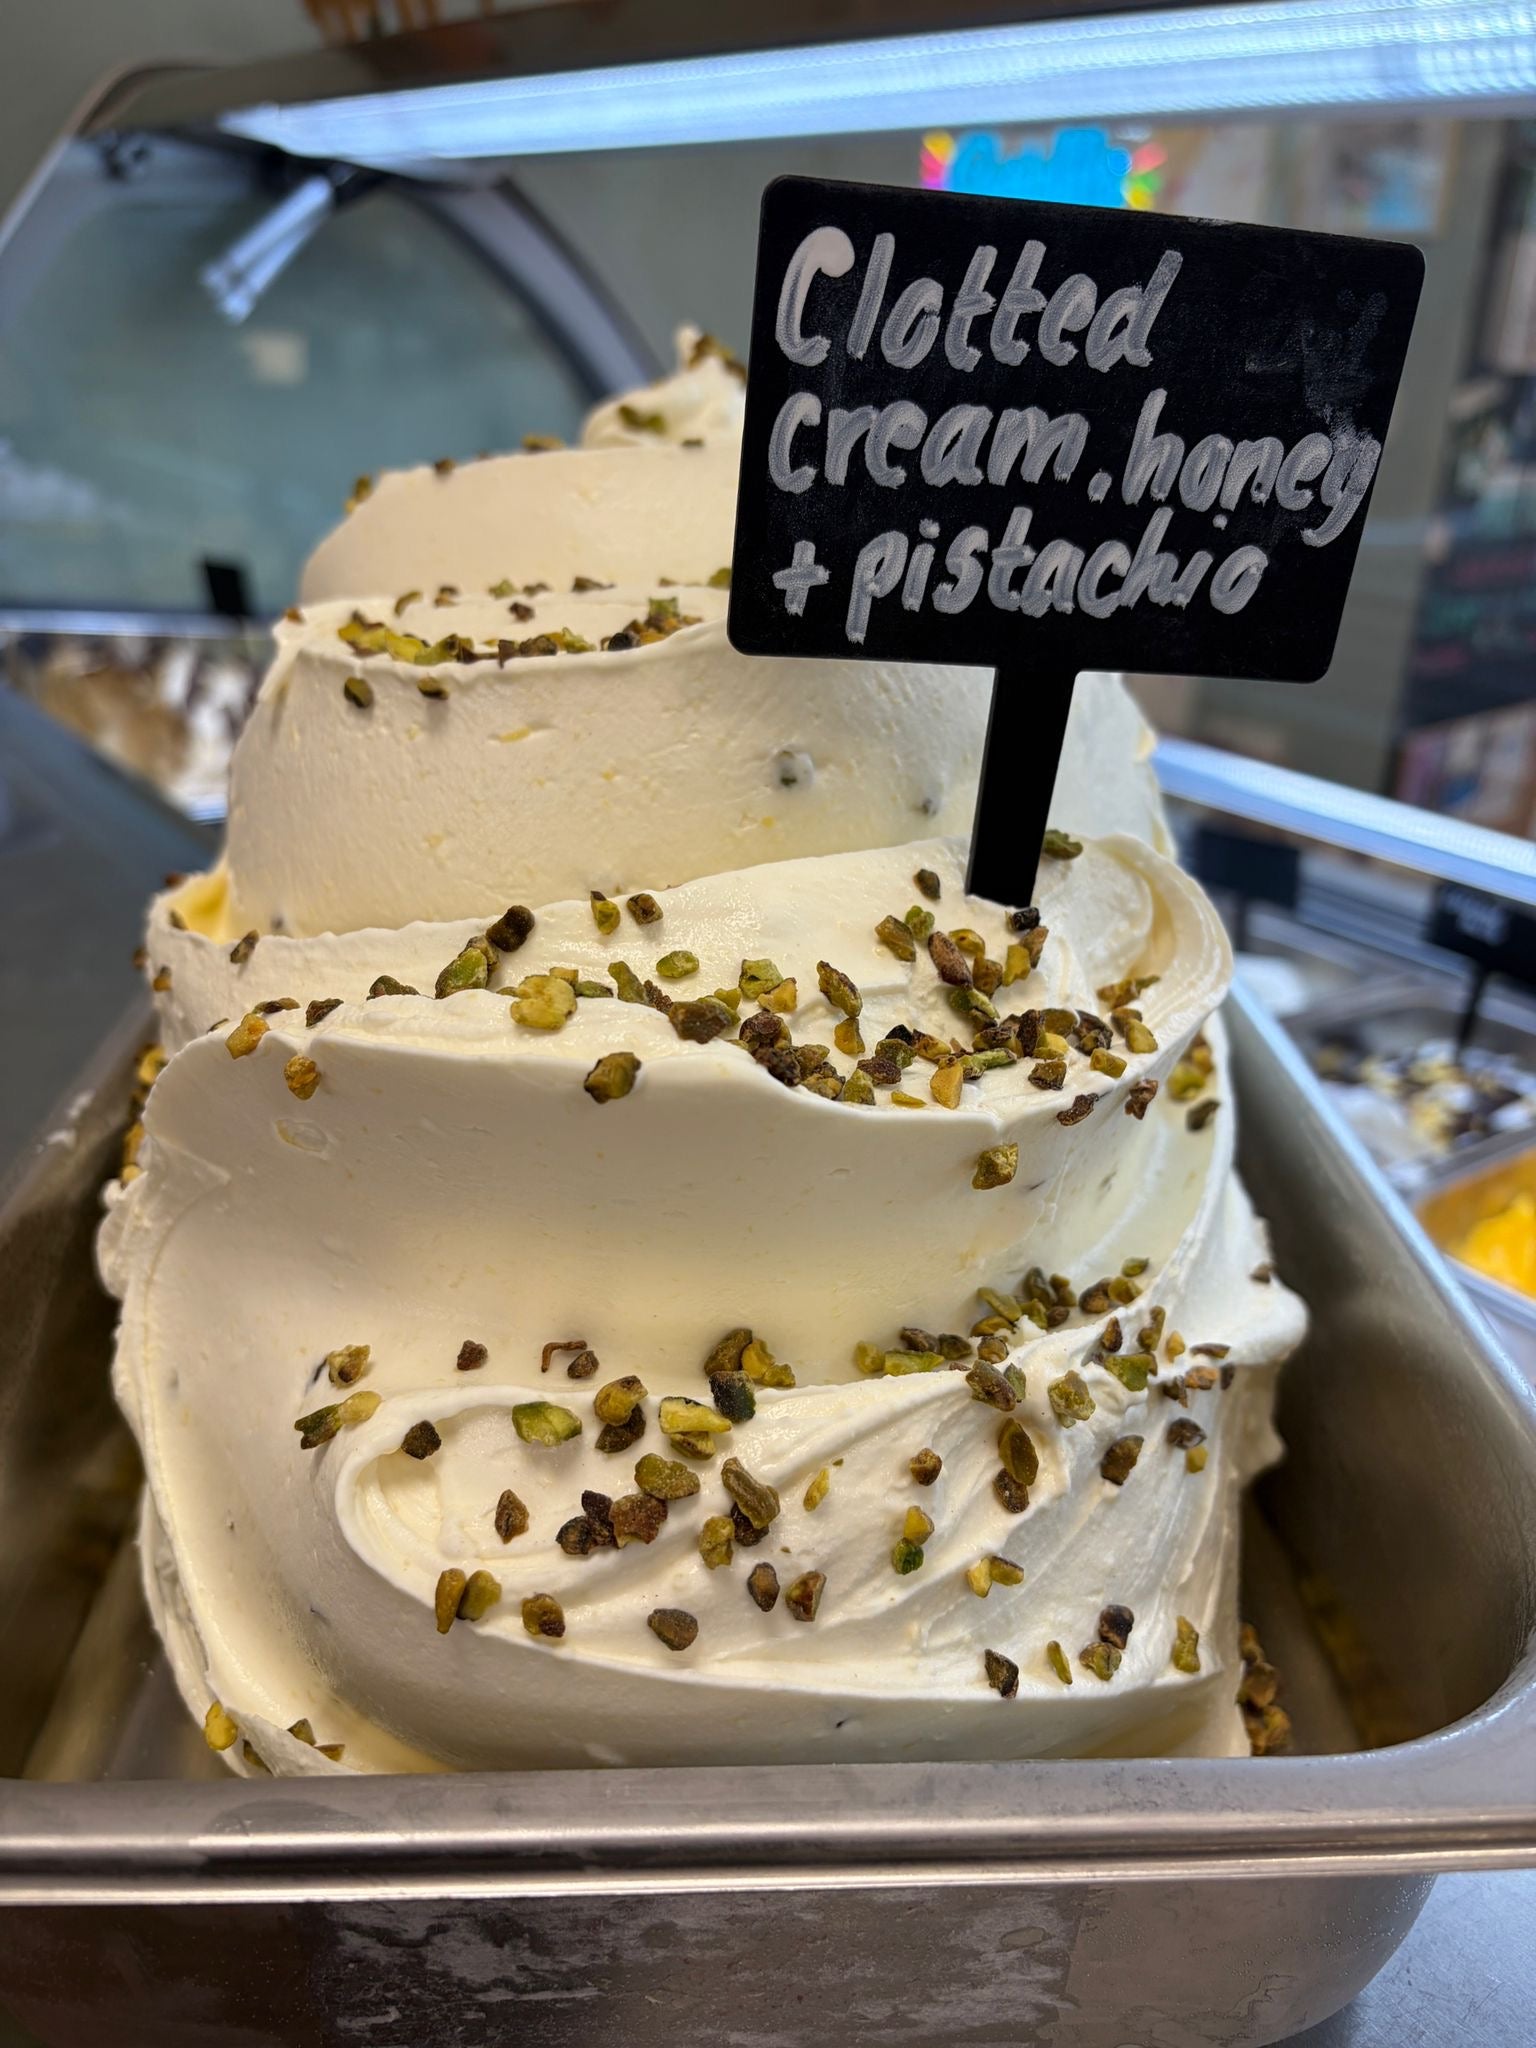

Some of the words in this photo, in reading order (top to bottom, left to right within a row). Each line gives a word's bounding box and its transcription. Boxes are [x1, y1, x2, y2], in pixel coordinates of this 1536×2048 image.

[775, 226, 1183, 373] Clotted
[1122, 388, 1382, 547] honey
[772, 540, 830, 617] +
[845, 506, 1269, 645] pistachio
